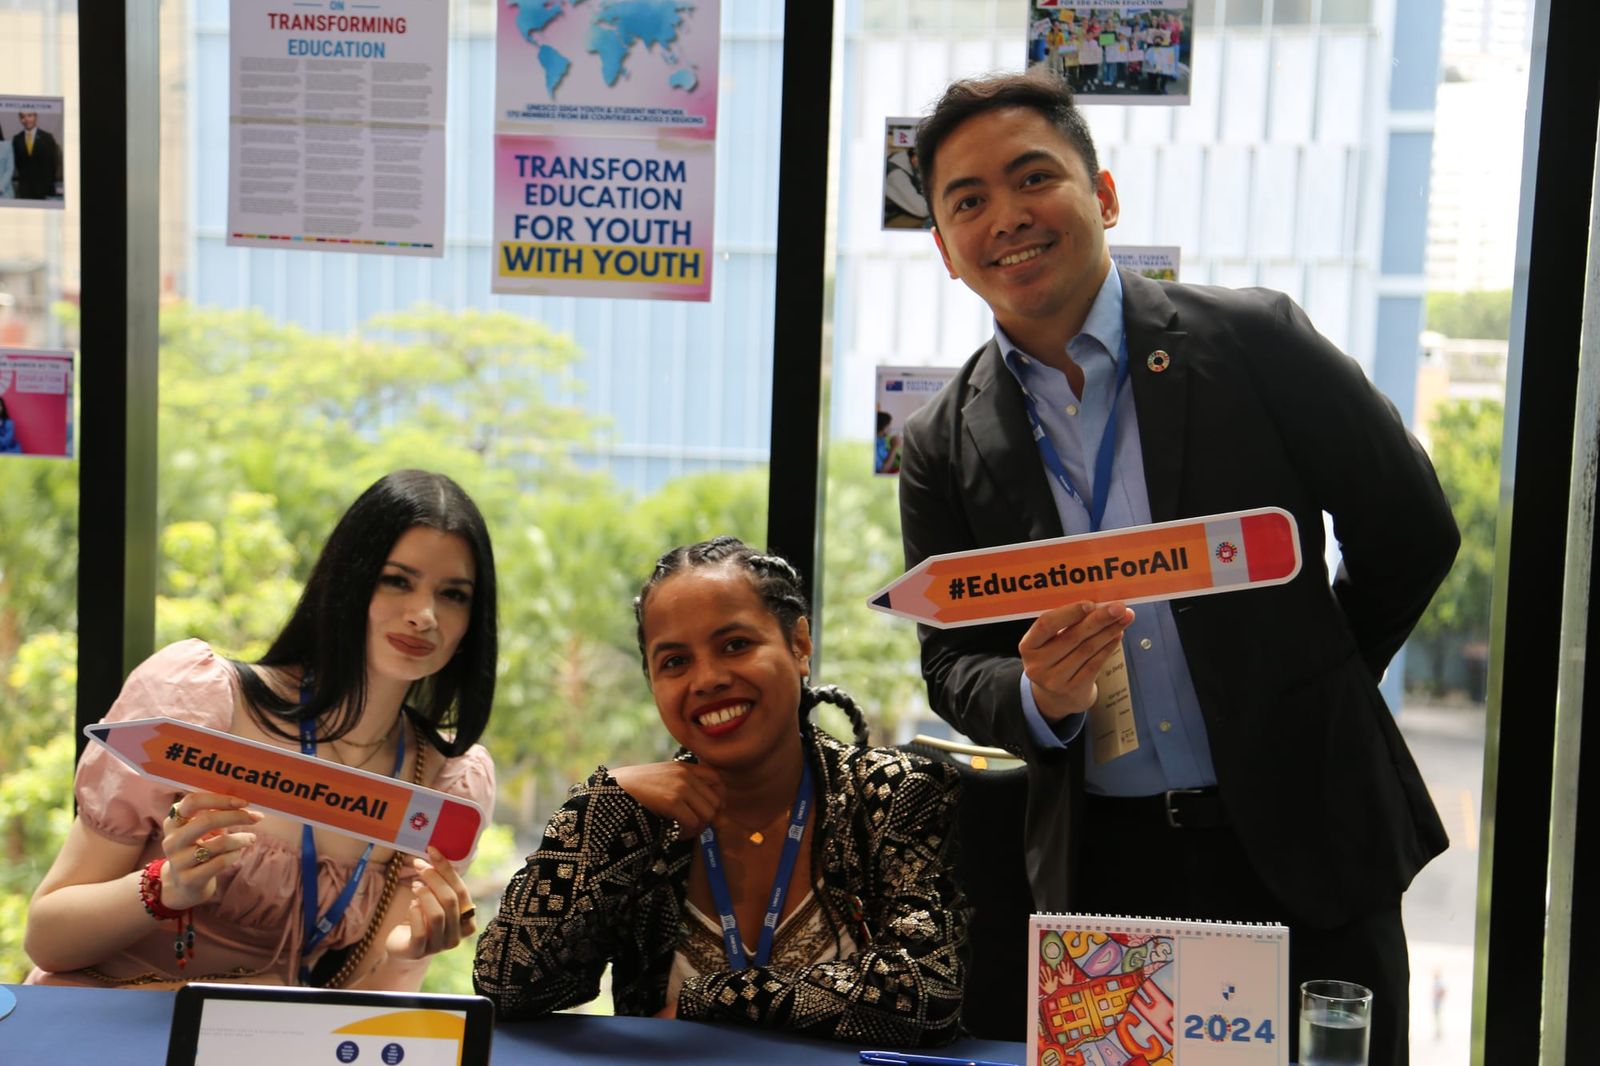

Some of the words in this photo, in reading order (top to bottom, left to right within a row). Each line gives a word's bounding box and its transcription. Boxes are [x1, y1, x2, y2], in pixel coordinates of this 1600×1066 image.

[329, 1, 345, 10] ON
[267, 12, 406, 34] TRANSFORMING
[288, 38, 385, 58] EDUCATION
[514, 155, 687, 183] TRANSFORM
[525, 183, 682, 210] EDUCATION
[514, 214, 575, 242] FOR
[585, 217, 692, 246] YOUTH
[503, 245, 583, 273] WITH
[593, 249, 700, 278] YOUTH
[948, 547, 1189, 600] #EducationForAll
[164, 741, 388, 820] #EducationForAll
[1184, 1013, 1276, 1044] 2024
